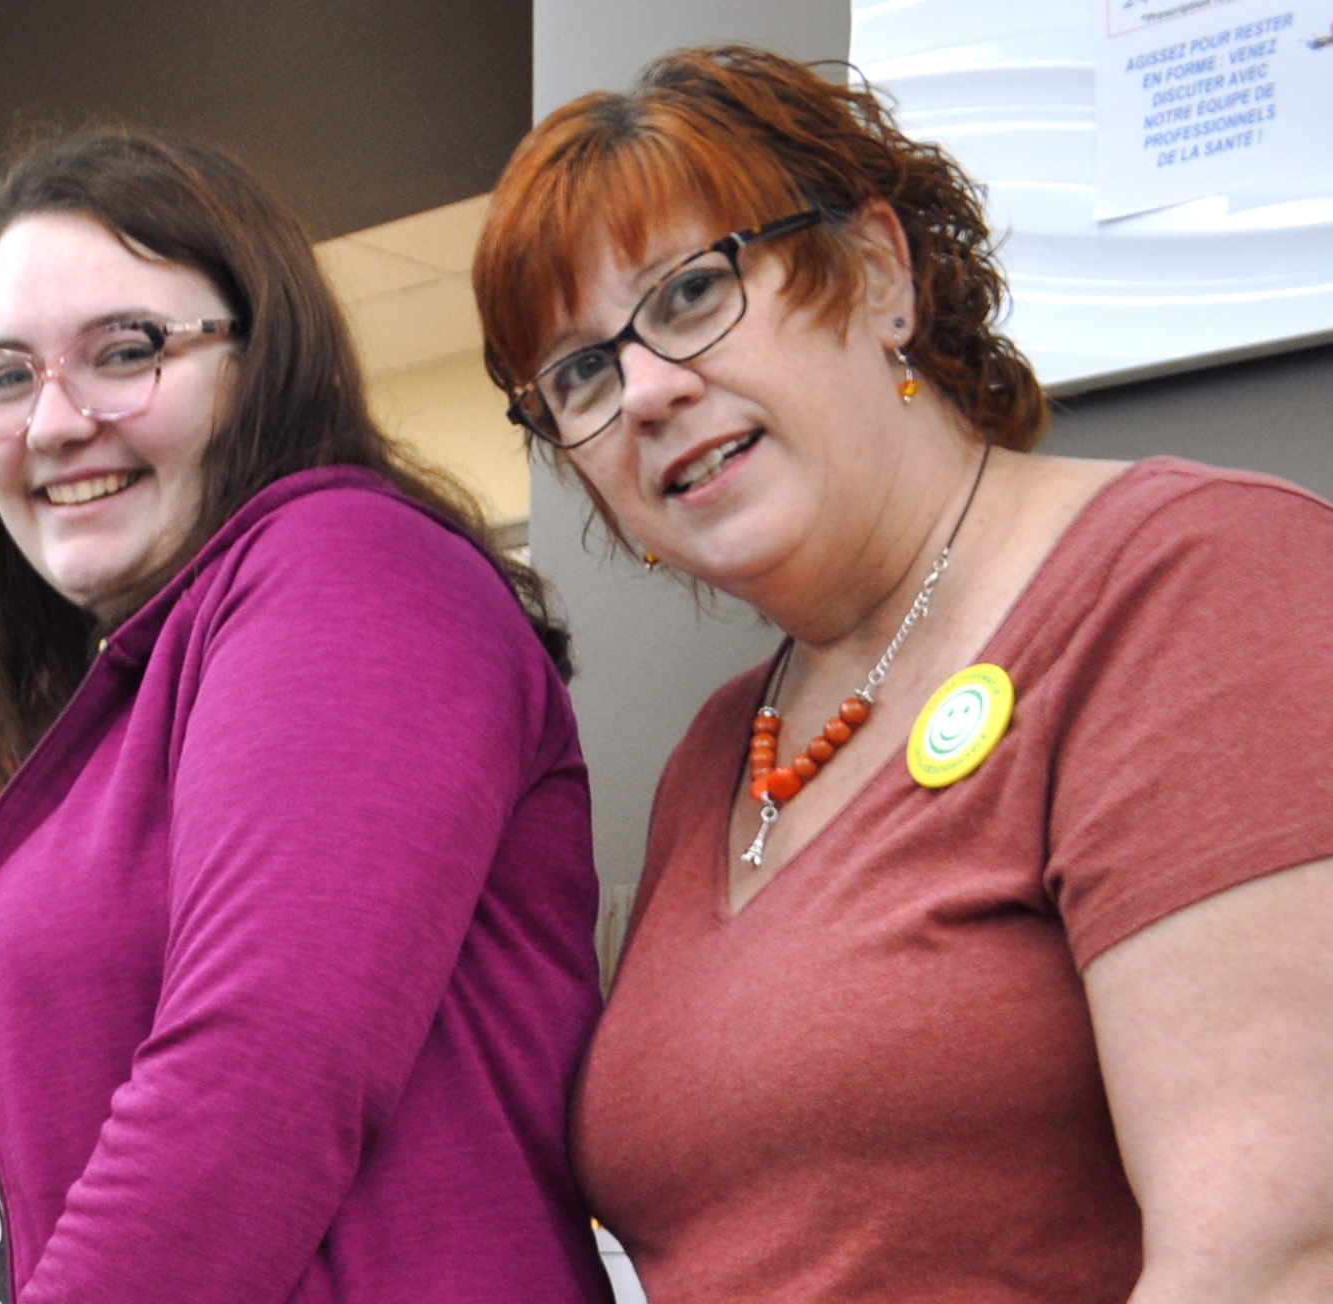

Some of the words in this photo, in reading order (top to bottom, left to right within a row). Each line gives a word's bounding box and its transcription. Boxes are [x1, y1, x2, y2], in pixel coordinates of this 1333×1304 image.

[1125, 43, 1186, 73] AGISSEZ
[1190, 30, 1231, 55] POUR
[1234, 12, 1294, 41] RESTER
[1142, 71, 1162, 89] EN
[1165, 55, 1216, 83] FORME
[1229, 38, 1277, 65] VENEZ
[1143, 104, 1192, 130] NOTRE
[1254, 81, 1276, 101] DE
[1152, 74, 1225, 108] DISCUTER
[1227, 62, 1269, 86] AVEC
[1143, 103, 1276, 151] PROFESSIONNELS
[1157, 149, 1176, 168] DE
[1180, 144, 1199, 162] LA
